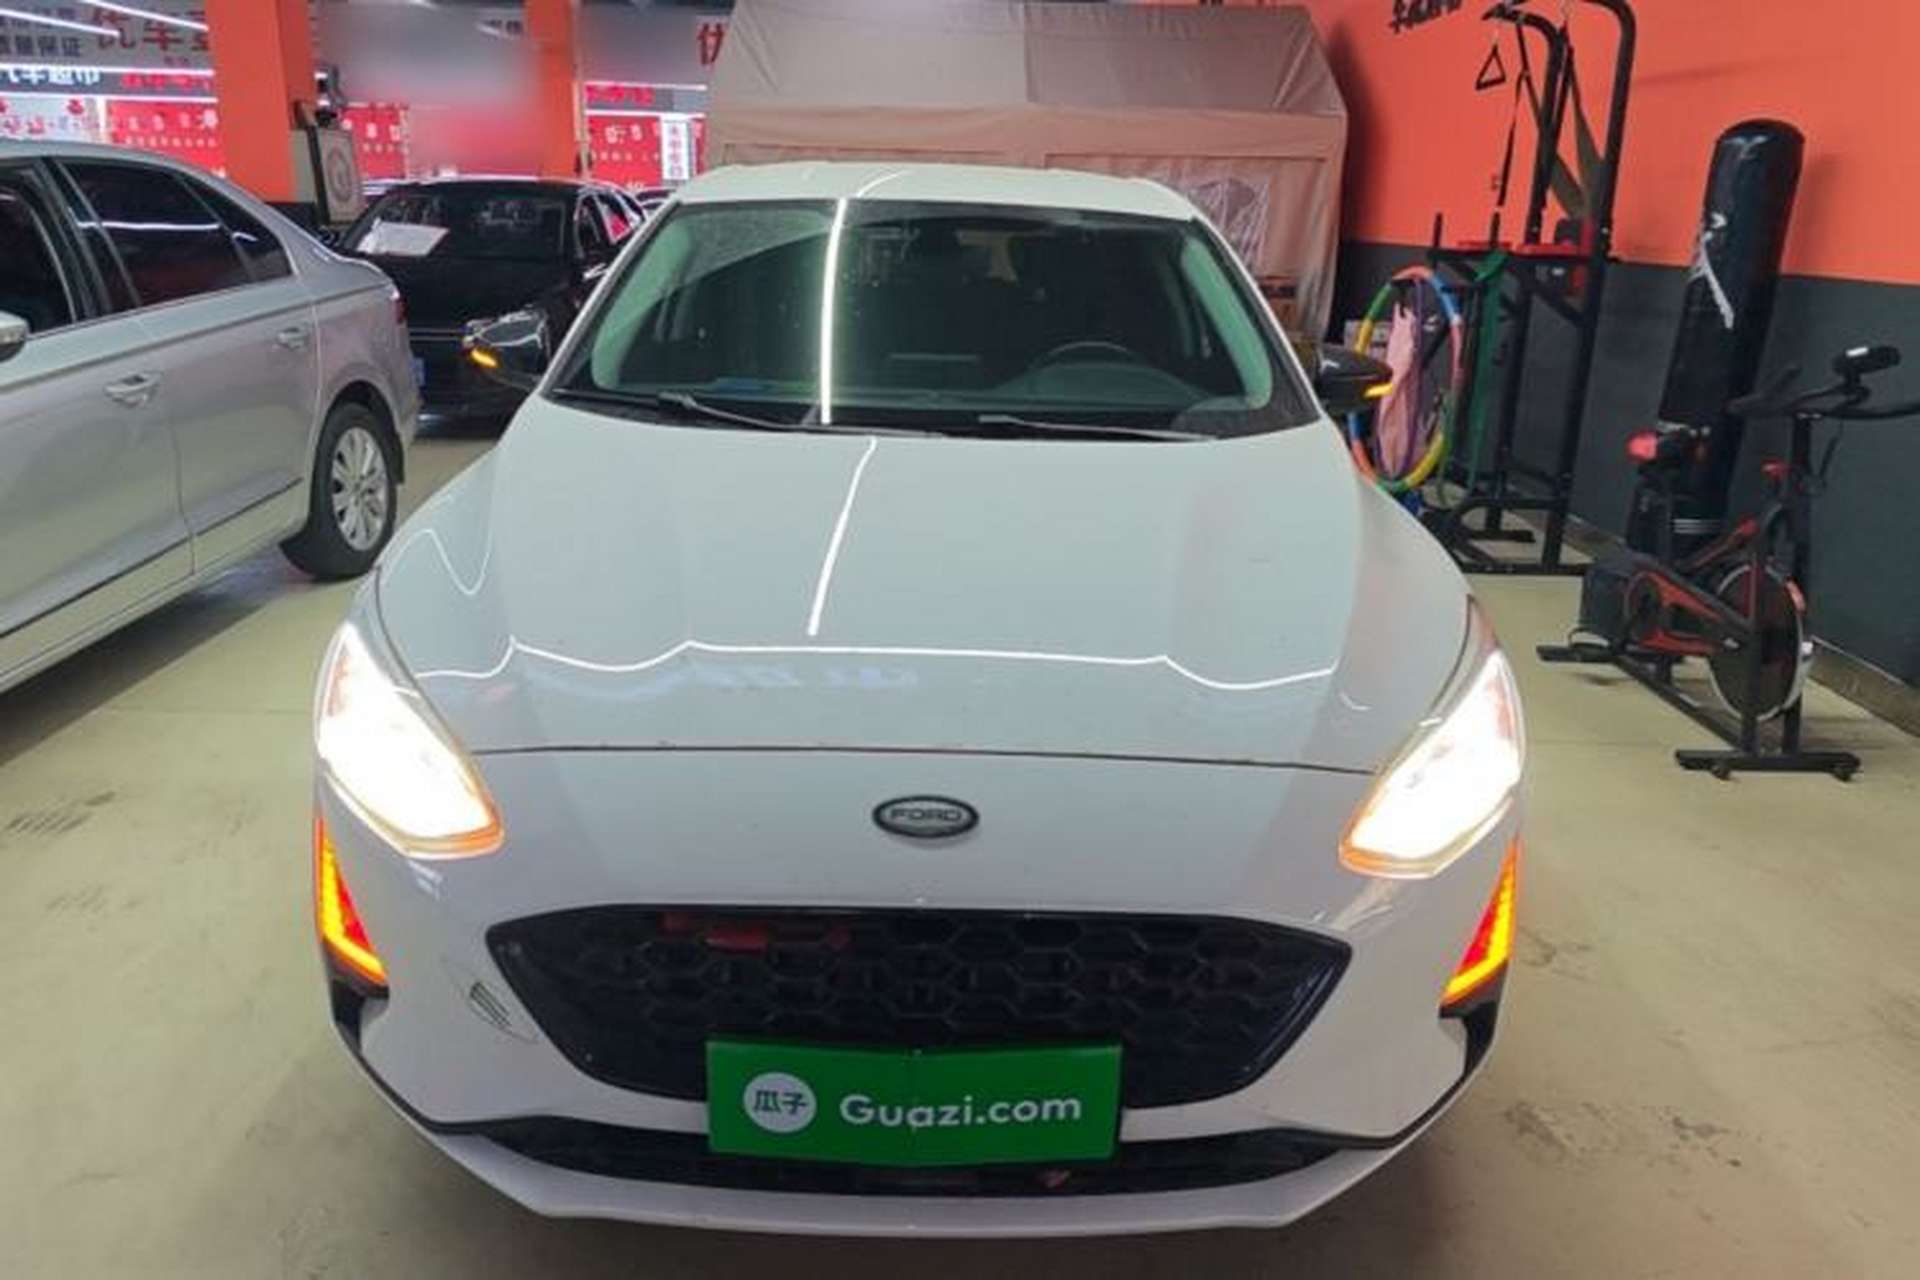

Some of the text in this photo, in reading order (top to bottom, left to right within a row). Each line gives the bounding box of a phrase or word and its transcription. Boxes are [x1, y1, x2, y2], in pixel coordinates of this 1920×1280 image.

[890, 807, 962, 821] FORD
[753, 1090, 1082, 1128] 瓜子 Guazi.com
